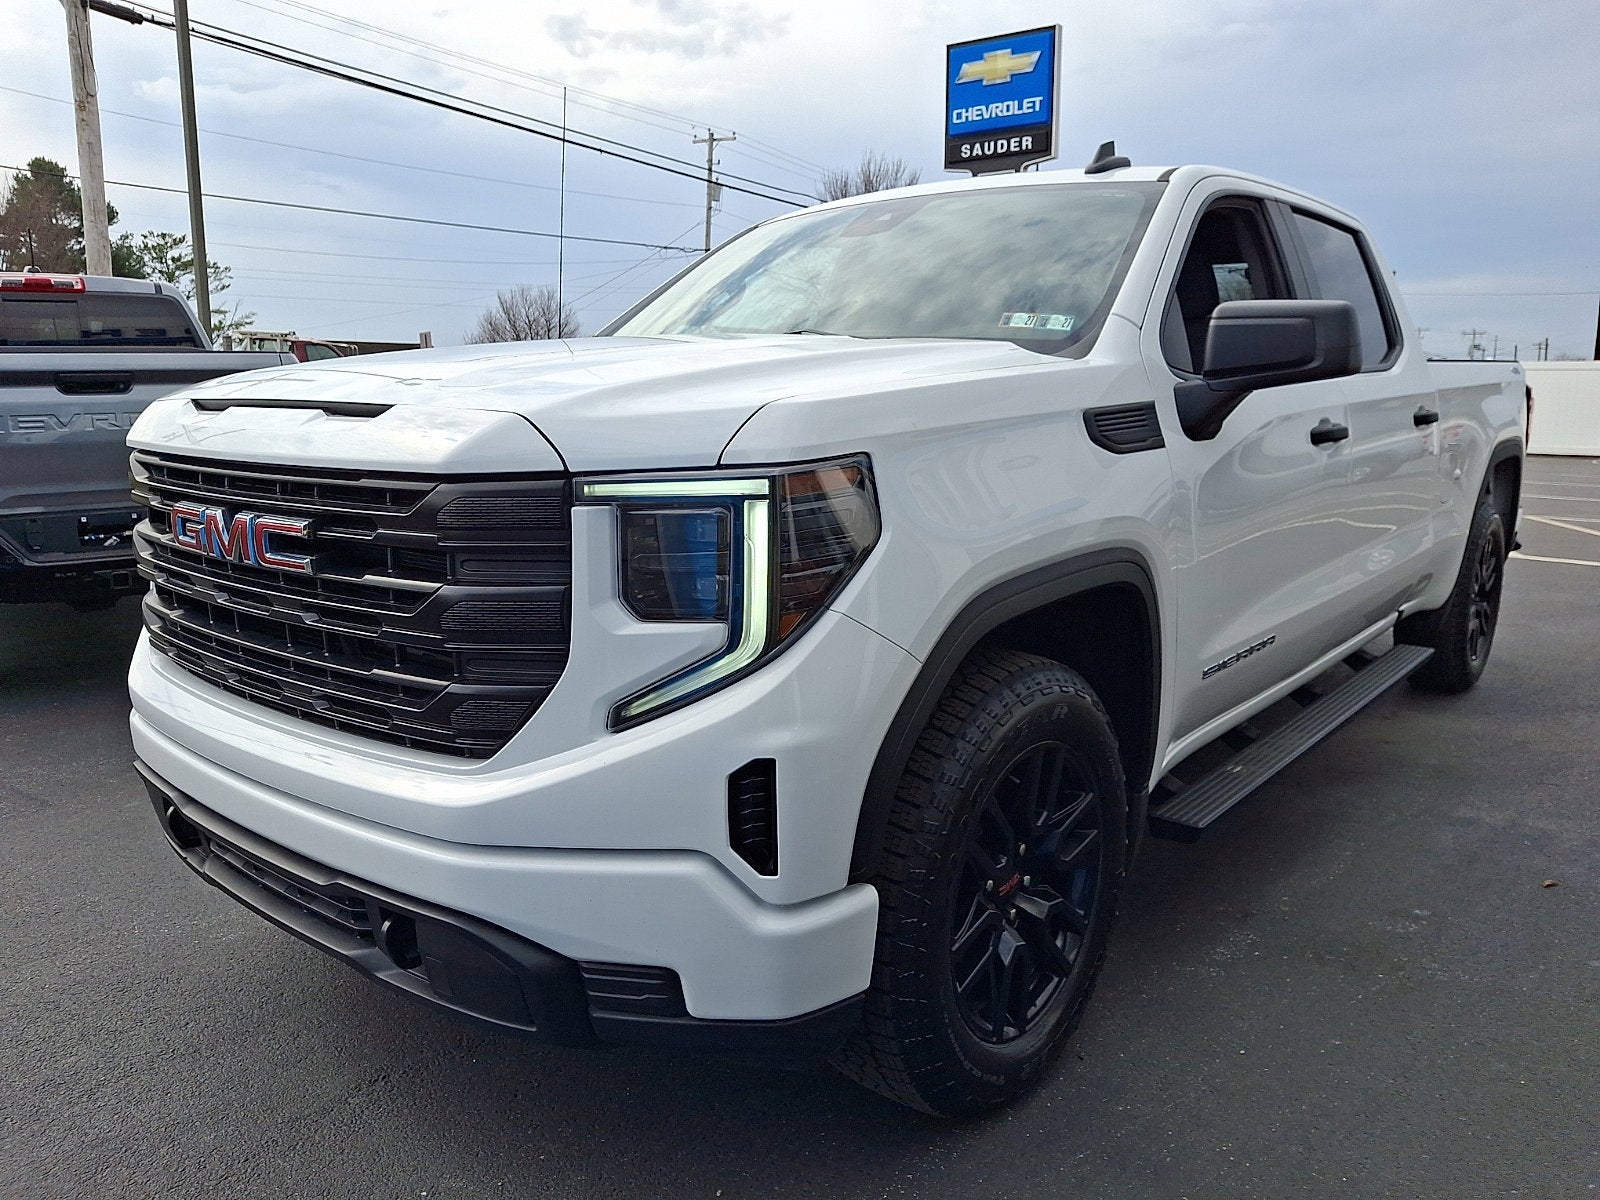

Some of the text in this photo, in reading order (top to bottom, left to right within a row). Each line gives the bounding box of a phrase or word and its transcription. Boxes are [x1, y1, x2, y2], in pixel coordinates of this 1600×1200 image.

[952, 96, 1043, 124] CHEVROLET
[960, 135, 1033, 158] SAUDER
[1024, 315, 1035, 326] 27
[1061, 317, 1072, 328] 27
[171, 501, 318, 576] GMC
